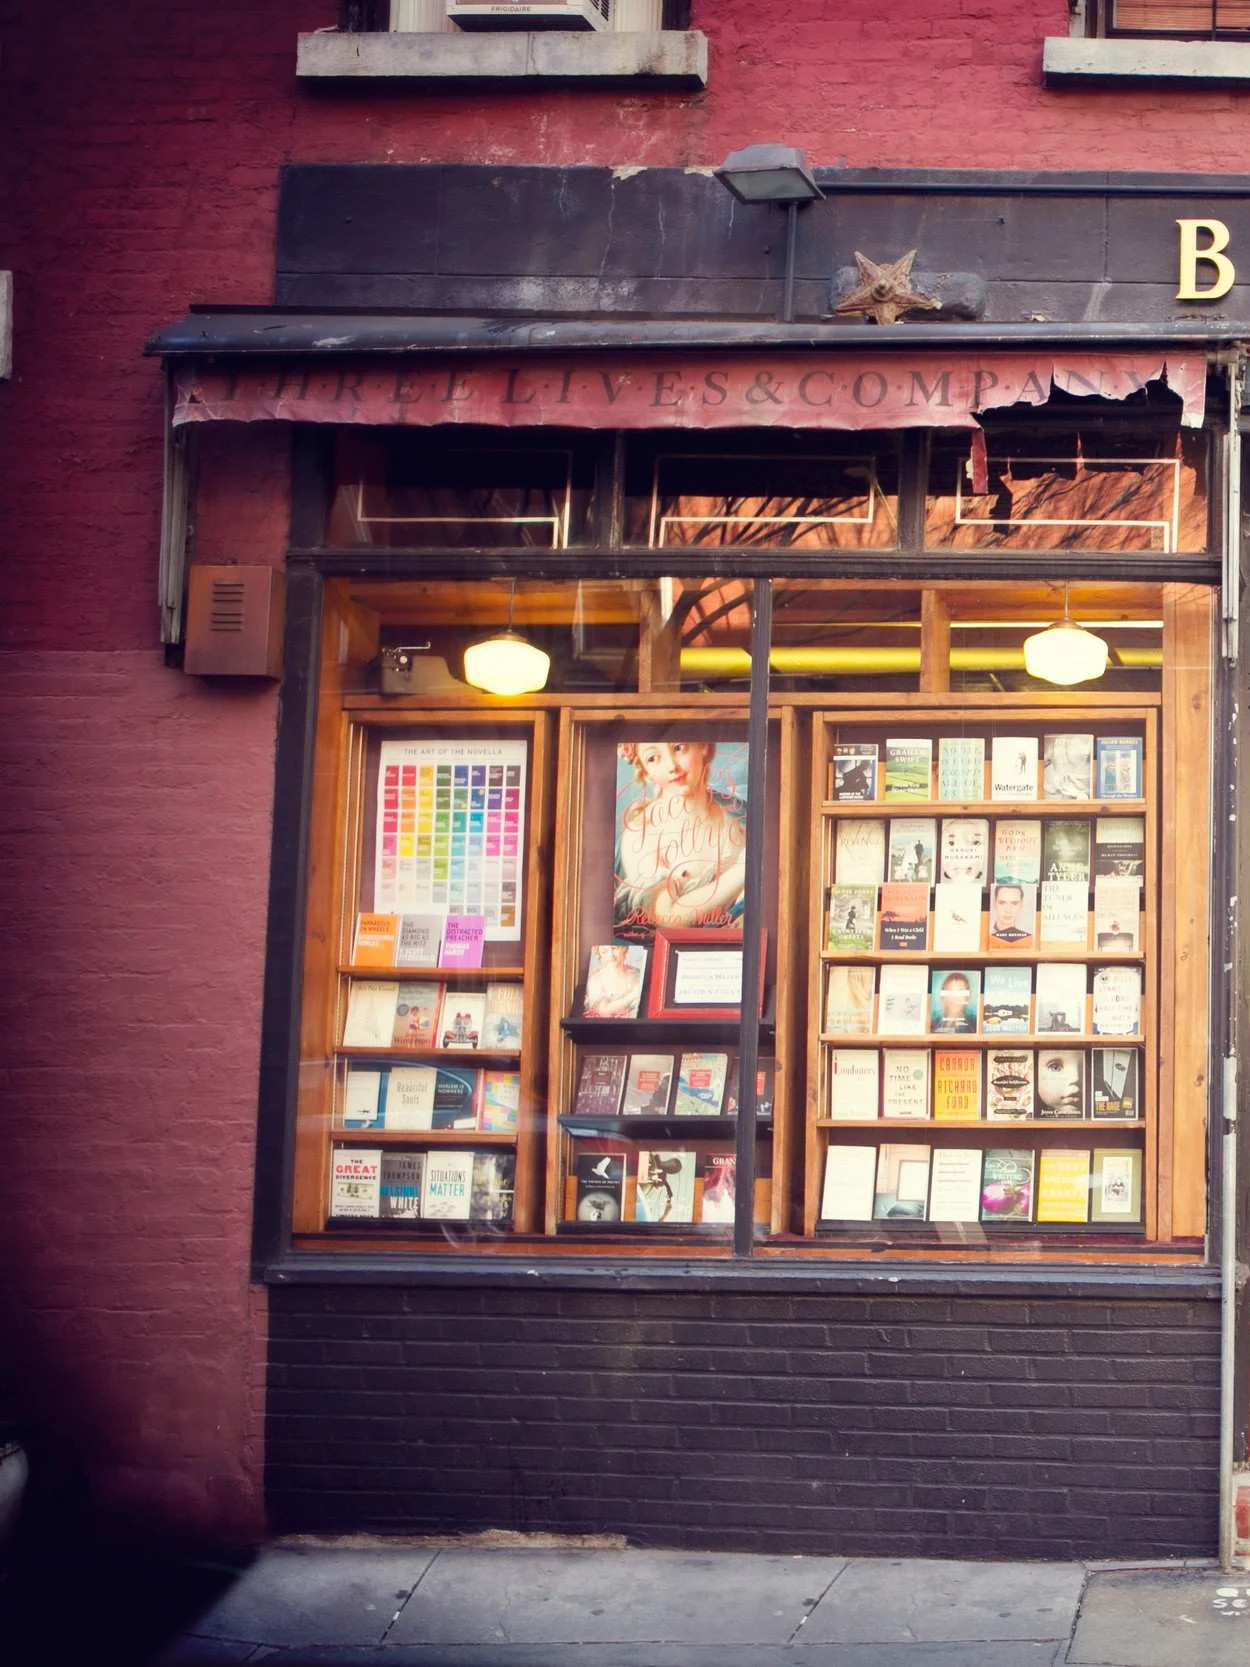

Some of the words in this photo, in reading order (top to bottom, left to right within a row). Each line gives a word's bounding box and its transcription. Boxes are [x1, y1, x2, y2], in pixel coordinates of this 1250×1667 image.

[745, 369, 785, 407] &
[404, 748, 418, 756] THE
[420, 748, 435, 756] ART
[437, 748, 448, 756] OF
[451, 748, 465, 756] THE
[467, 748, 503, 756] NOVELLA
[994, 784, 1034, 792] Watergate
[1048, 872, 1086, 881] TYLER
[895, 1065, 910, 1073] NO
[889, 1074, 911, 1082] TIME
[396, 1080, 428, 1093] Beautiful
[938, 1080, 978, 1094] RICHARD
[401, 1094, 420, 1106] Souls
[888, 1098, 924, 1106] PRESENT
[947, 1096, 969, 1110] FORD
[713, 1157, 737, 1165] GRAN
[335, 1165, 378, 1174] GREAT
[430, 1170, 466, 1183] SITUATIONS
[429, 1184, 465, 1197] MATTER
[390, 1196, 419, 1210] WHITE
